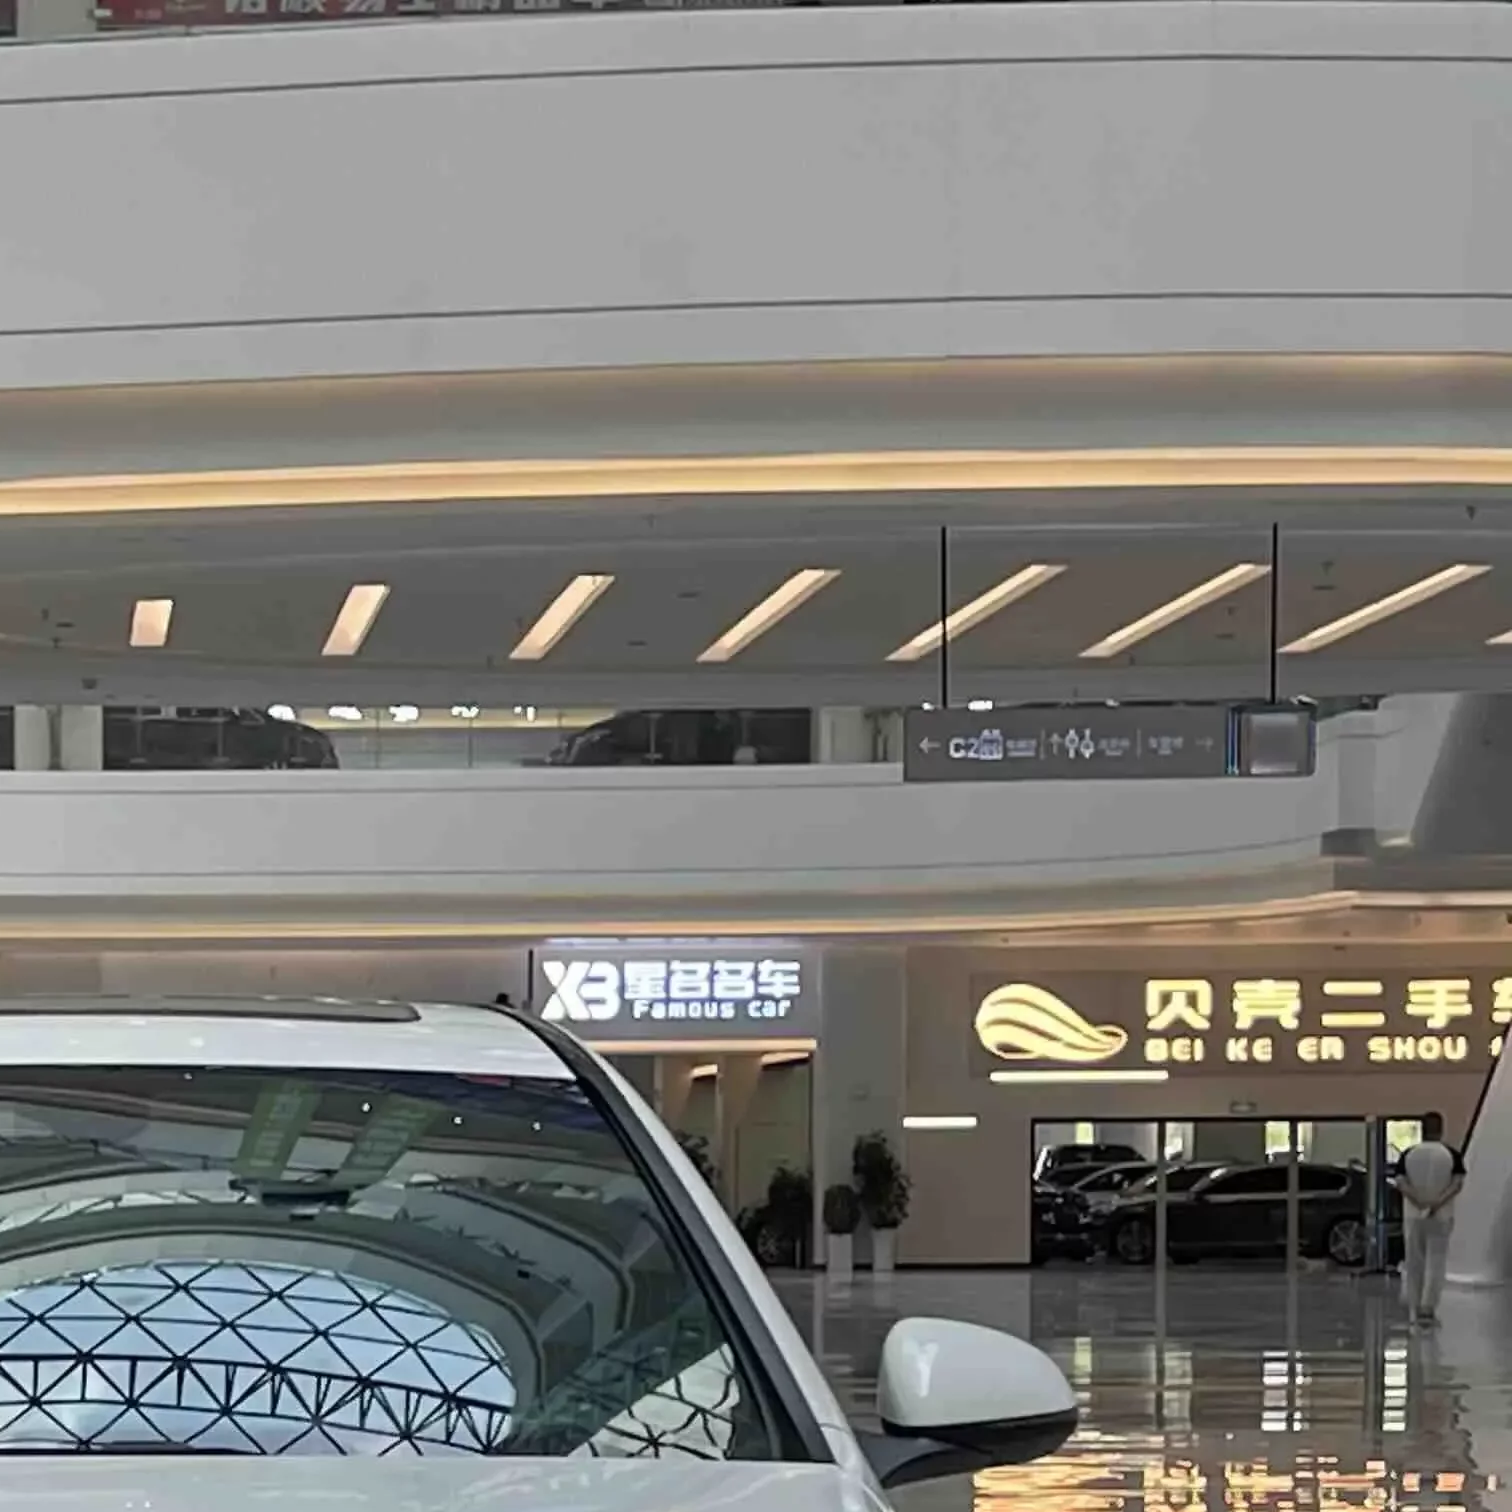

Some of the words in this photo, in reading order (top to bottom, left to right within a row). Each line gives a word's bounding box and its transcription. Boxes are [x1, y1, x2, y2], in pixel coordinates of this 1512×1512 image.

[633, 1000, 735, 1019] Famous
[1144, 1036, 1205, 1062] BEI
[1226, 1036, 1273, 1062] KE
[1297, 1036, 1346, 1062] ER
[1367, 1035, 1468, 1062] SHOU
